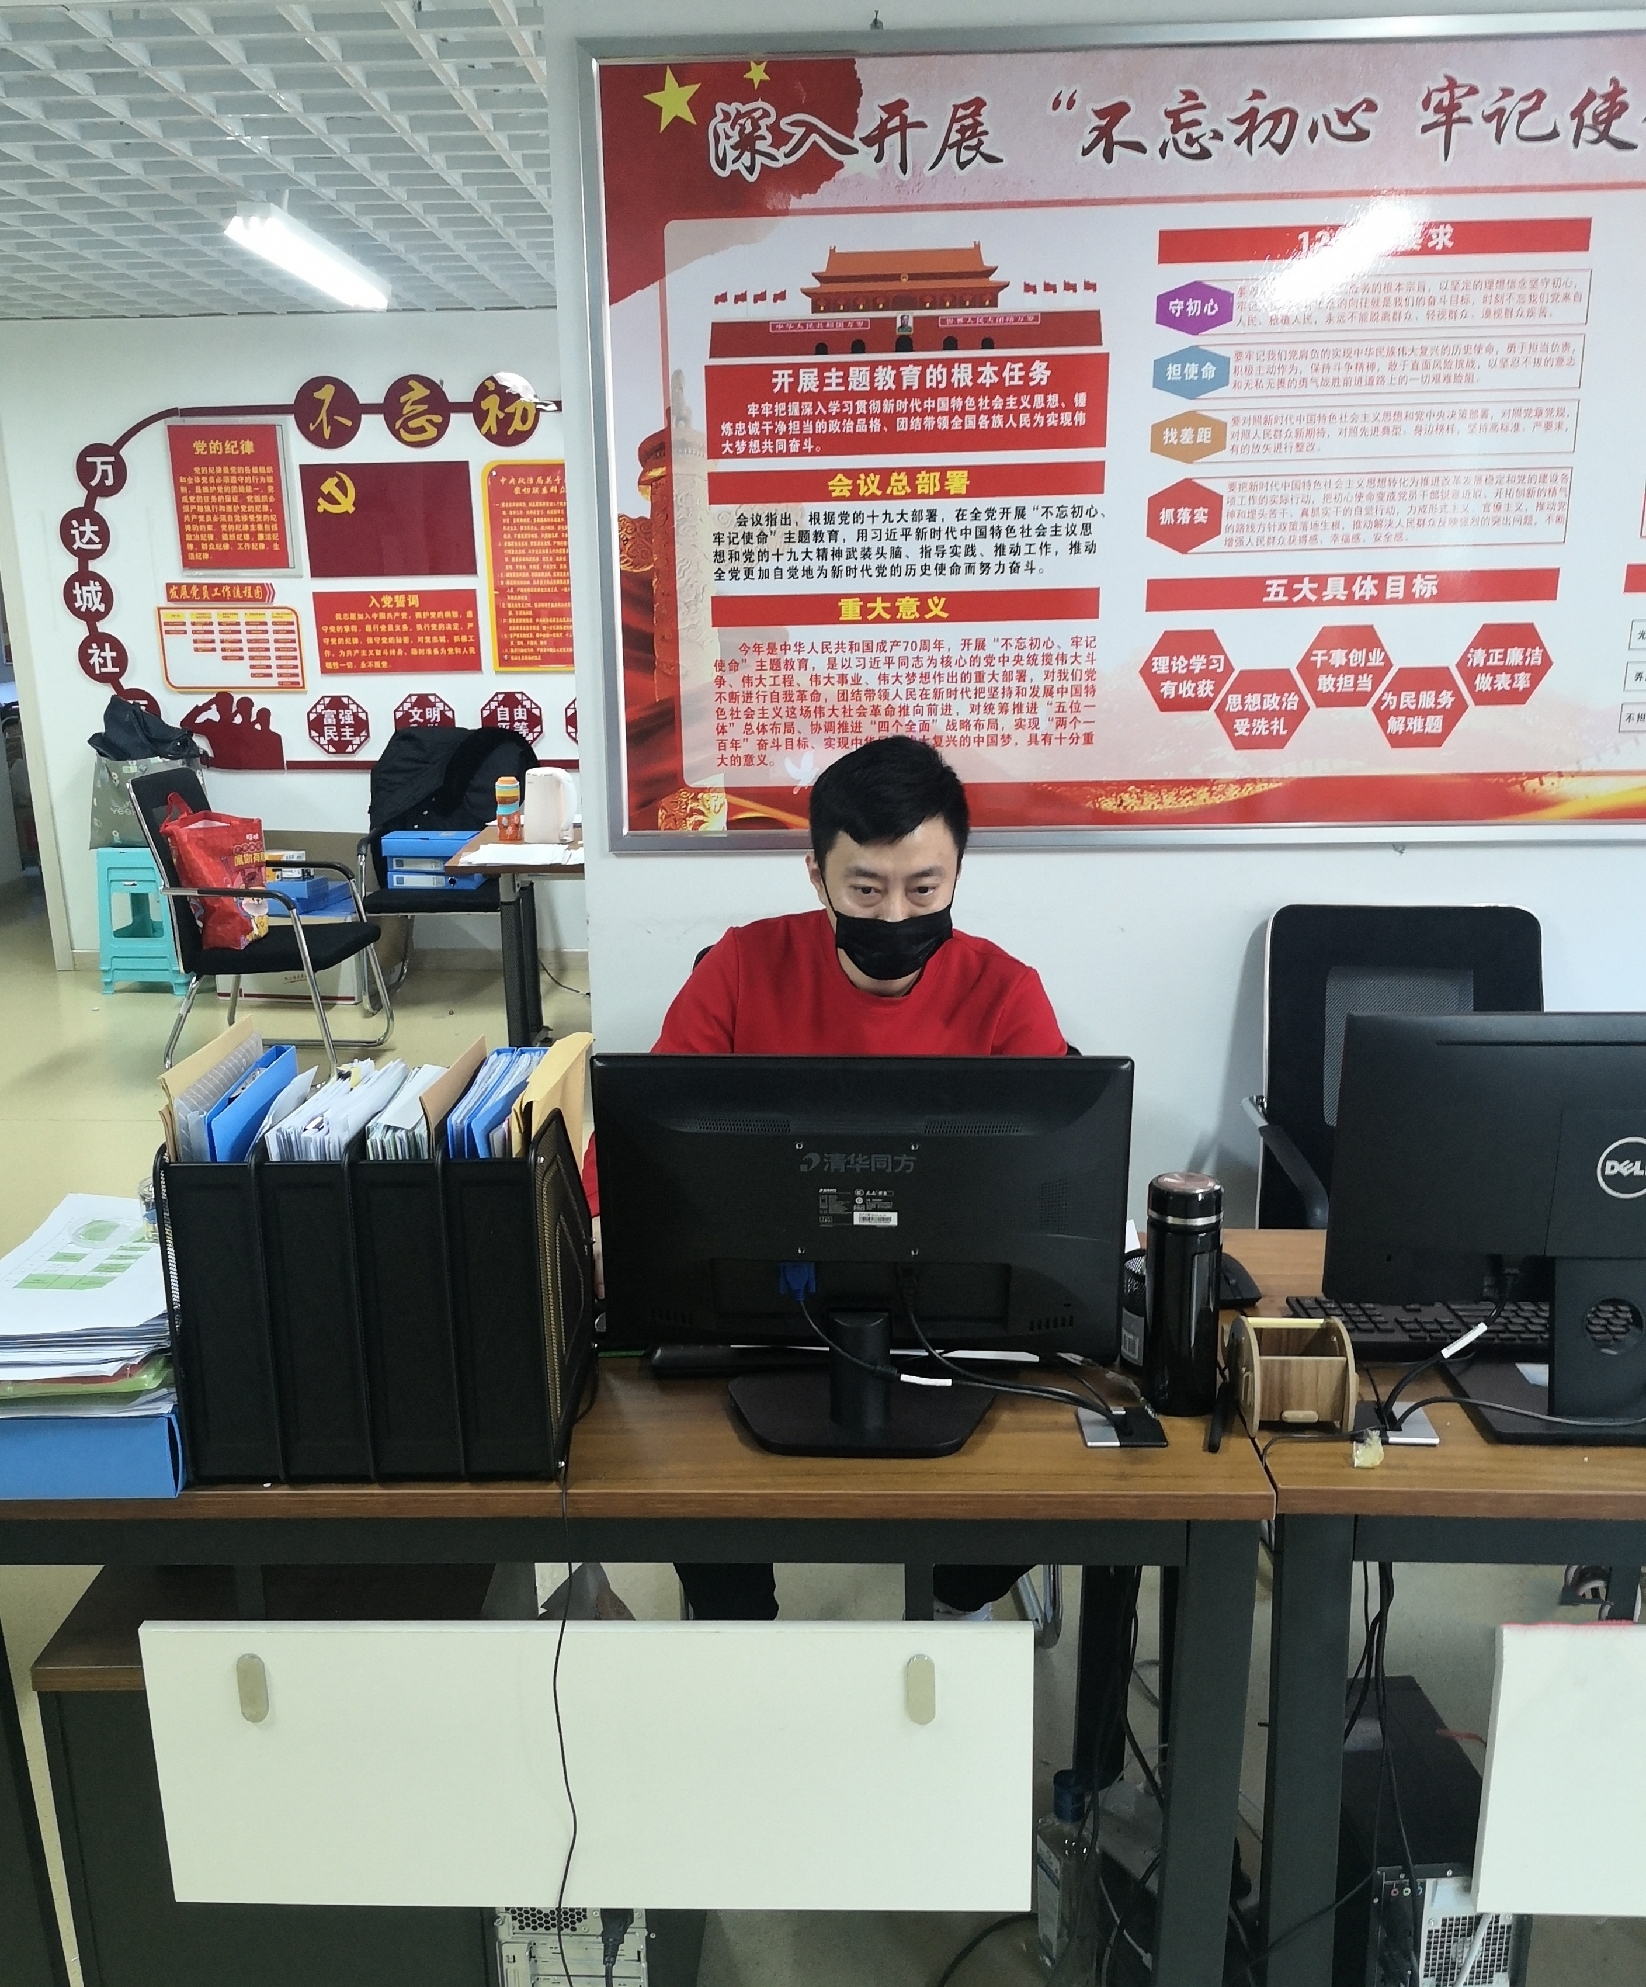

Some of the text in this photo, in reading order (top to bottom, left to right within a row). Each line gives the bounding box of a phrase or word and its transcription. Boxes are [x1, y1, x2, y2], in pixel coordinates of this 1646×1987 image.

[712, 96, 1005, 178] 深入开展
[1420, 73, 1646, 162] 牢记使
[1168, 297, 1219, 317] 守初心
[771, 359, 1052, 393] 开展主题教育的根本任务
[1166, 361, 1218, 381] 担使命
[308, 379, 537, 443] 不忘初
[1163, 425, 1212, 446] 找差距
[193, 439, 254, 455] 党的纪律
[721, 438, 823, 455] 大梦想共同奋斗。
[827, 470, 971, 497] 会议总部署
[1159, 506, 1208, 526] 抓落实
[713, 559, 1045, 583] 全党更加自觉地为新时代党的历史使命而努力奋斗。
[1263, 574, 1439, 602] 五大具体目标
[369, 594, 420, 608] 入党誓词
[838, 596, 950, 621] 重大意义
[1151, 653, 1225, 674] 理论学习
[1310, 647, 1385, 668] 干事创业
[1466, 646, 1541, 668] 清正廉洁
[1160, 679, 1215, 699] 有收获
[1317, 673, 1373, 694] 敢担当
[1474, 672, 1531, 693] 做表率
[1225, 691, 1299, 713] 思想政治
[1380, 690, 1455, 711] 为民服务
[322, 709, 354, 725] 富强
[409, 706, 441, 723] 文明
[497, 705, 527, 721] 自由
[324, 726, 355, 741] 民主
[1233, 716, 1288, 737] 受洗礼
[1387, 714, 1443, 734] 解难题
[716, 753, 777, 768] 大的意义。
[823, 1153, 917, 1173] 清华同方
[1604, 1159, 1646, 1177] DEL
